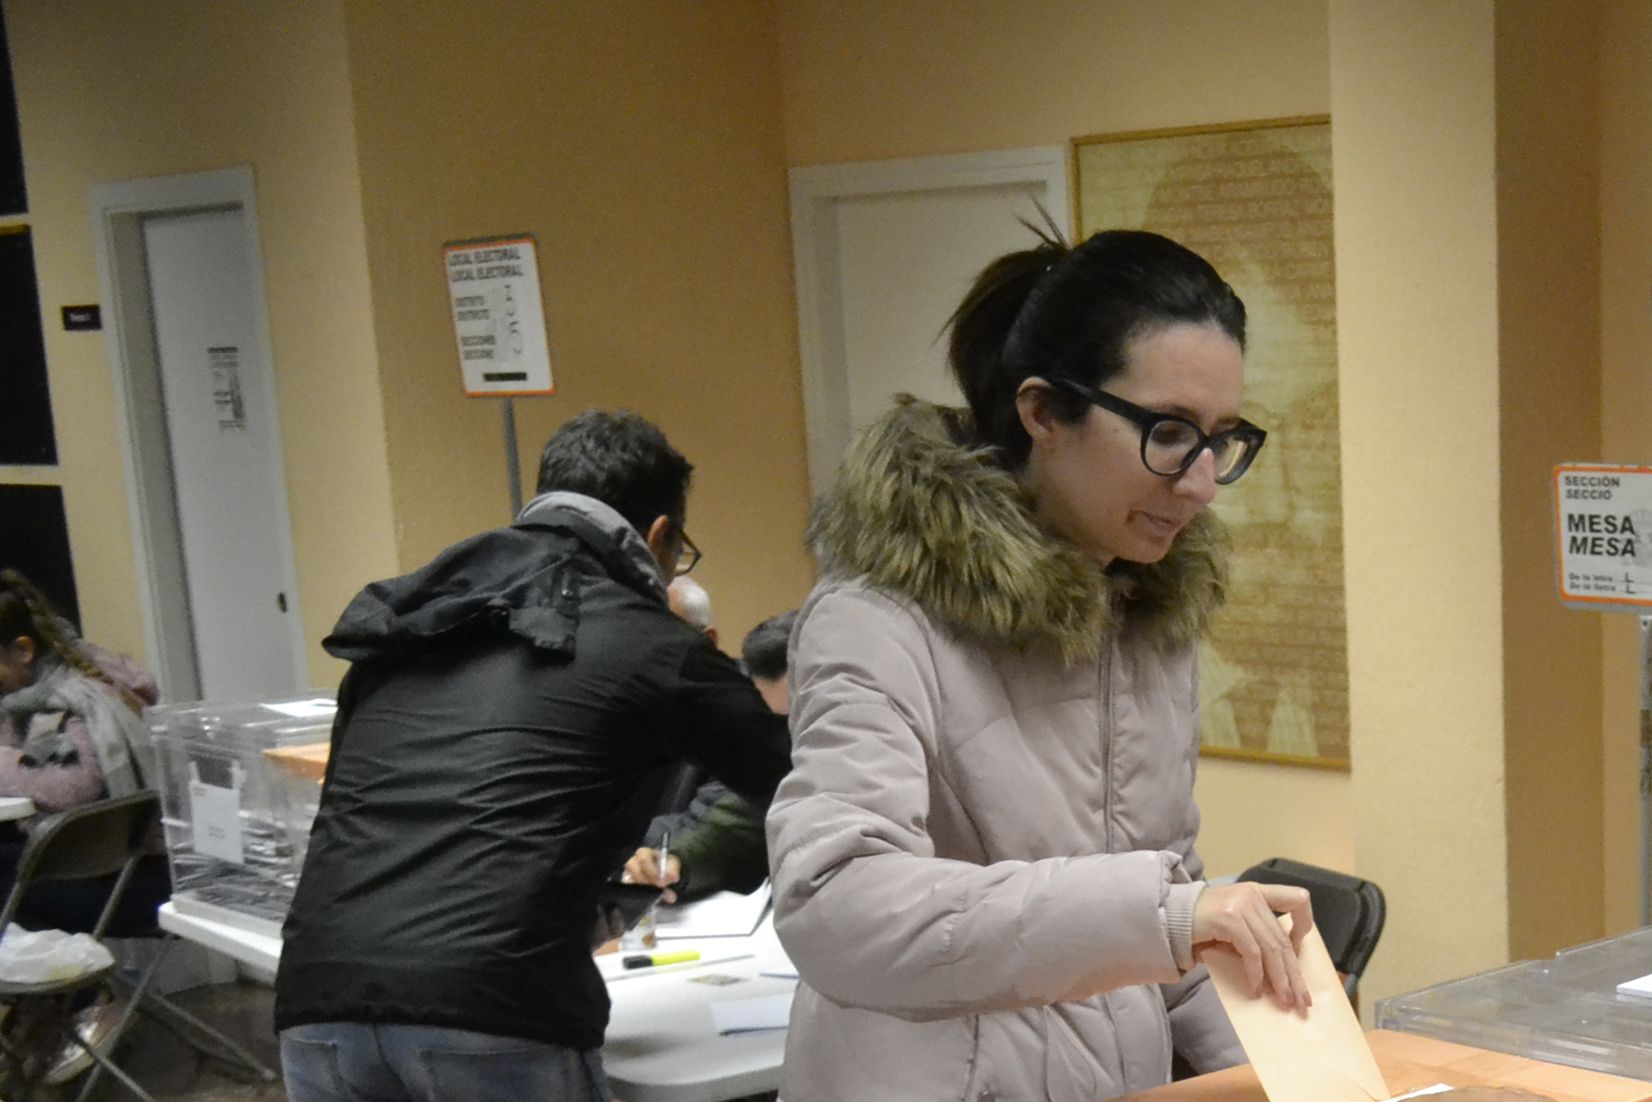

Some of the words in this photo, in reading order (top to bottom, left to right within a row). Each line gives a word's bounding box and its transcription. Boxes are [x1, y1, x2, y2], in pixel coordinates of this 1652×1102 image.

[474, 247, 521, 264] ELECTORAL
[476, 264, 523, 280] ELECTORAL
[1567, 513, 1636, 535] MESA
[1568, 535, 1636, 557] MESA
